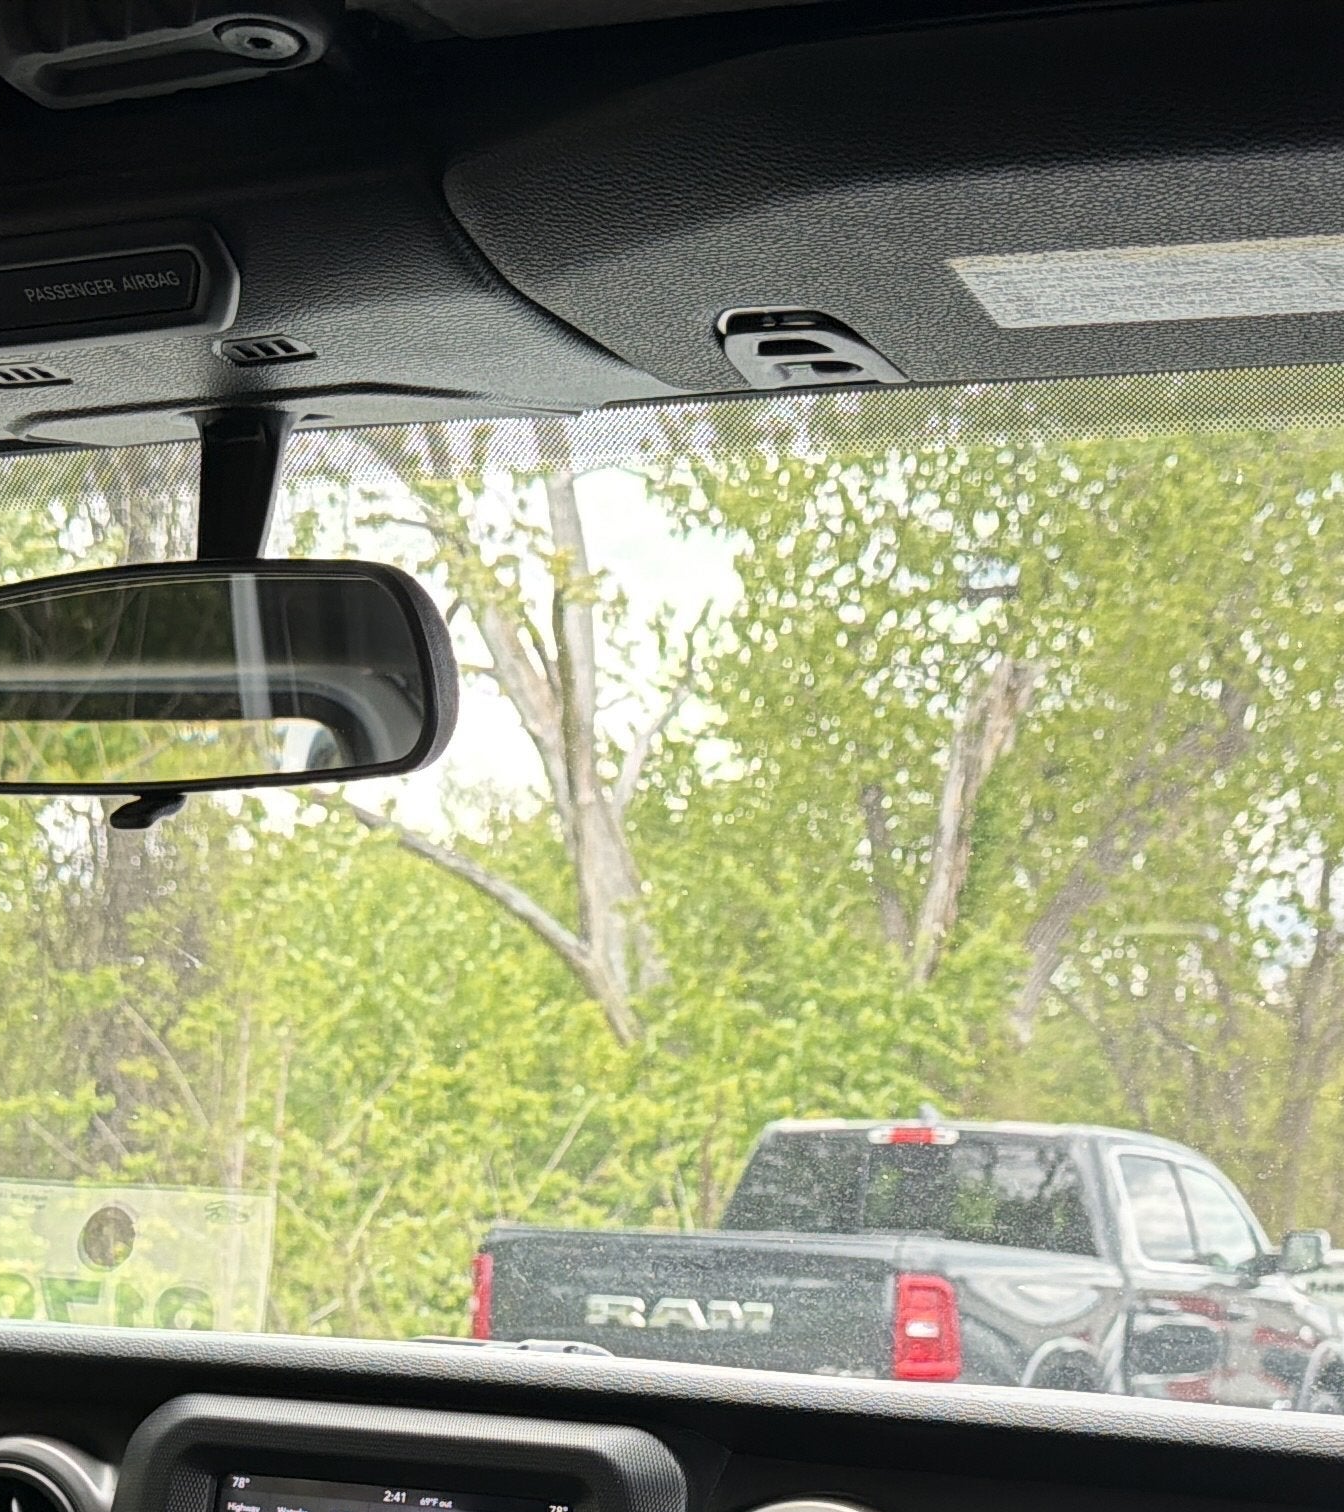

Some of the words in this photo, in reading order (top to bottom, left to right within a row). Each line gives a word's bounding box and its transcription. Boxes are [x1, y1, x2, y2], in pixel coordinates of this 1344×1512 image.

[24, 279, 117, 302] PASSENGER
[122, 270, 180, 291] AIRBAG
[585, 1294, 774, 1333] RAM
[232, 1476, 251, 1489] 78°
[383, 1490, 406, 1503] 2:41
